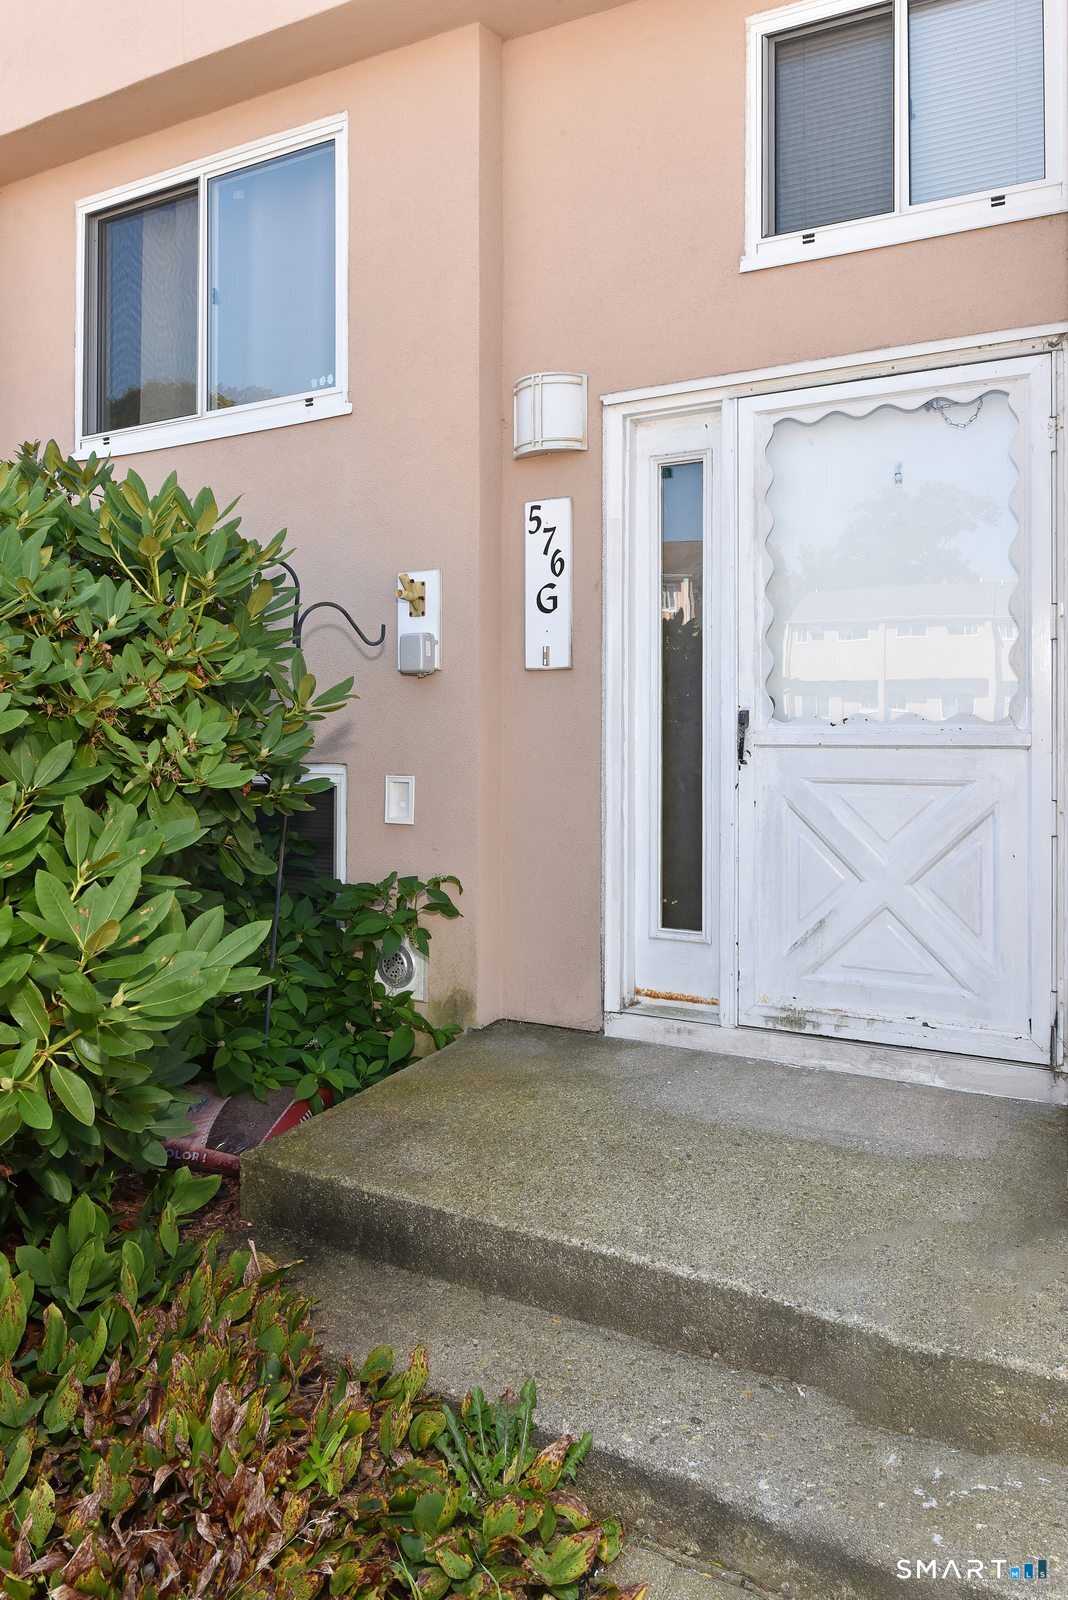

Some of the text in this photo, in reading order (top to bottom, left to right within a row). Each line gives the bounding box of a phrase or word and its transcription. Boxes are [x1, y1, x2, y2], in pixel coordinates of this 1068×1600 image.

[528, 504, 565, 578] 576
[536, 582, 558, 614] G
[166, 1148, 207, 1163] OLOR!
